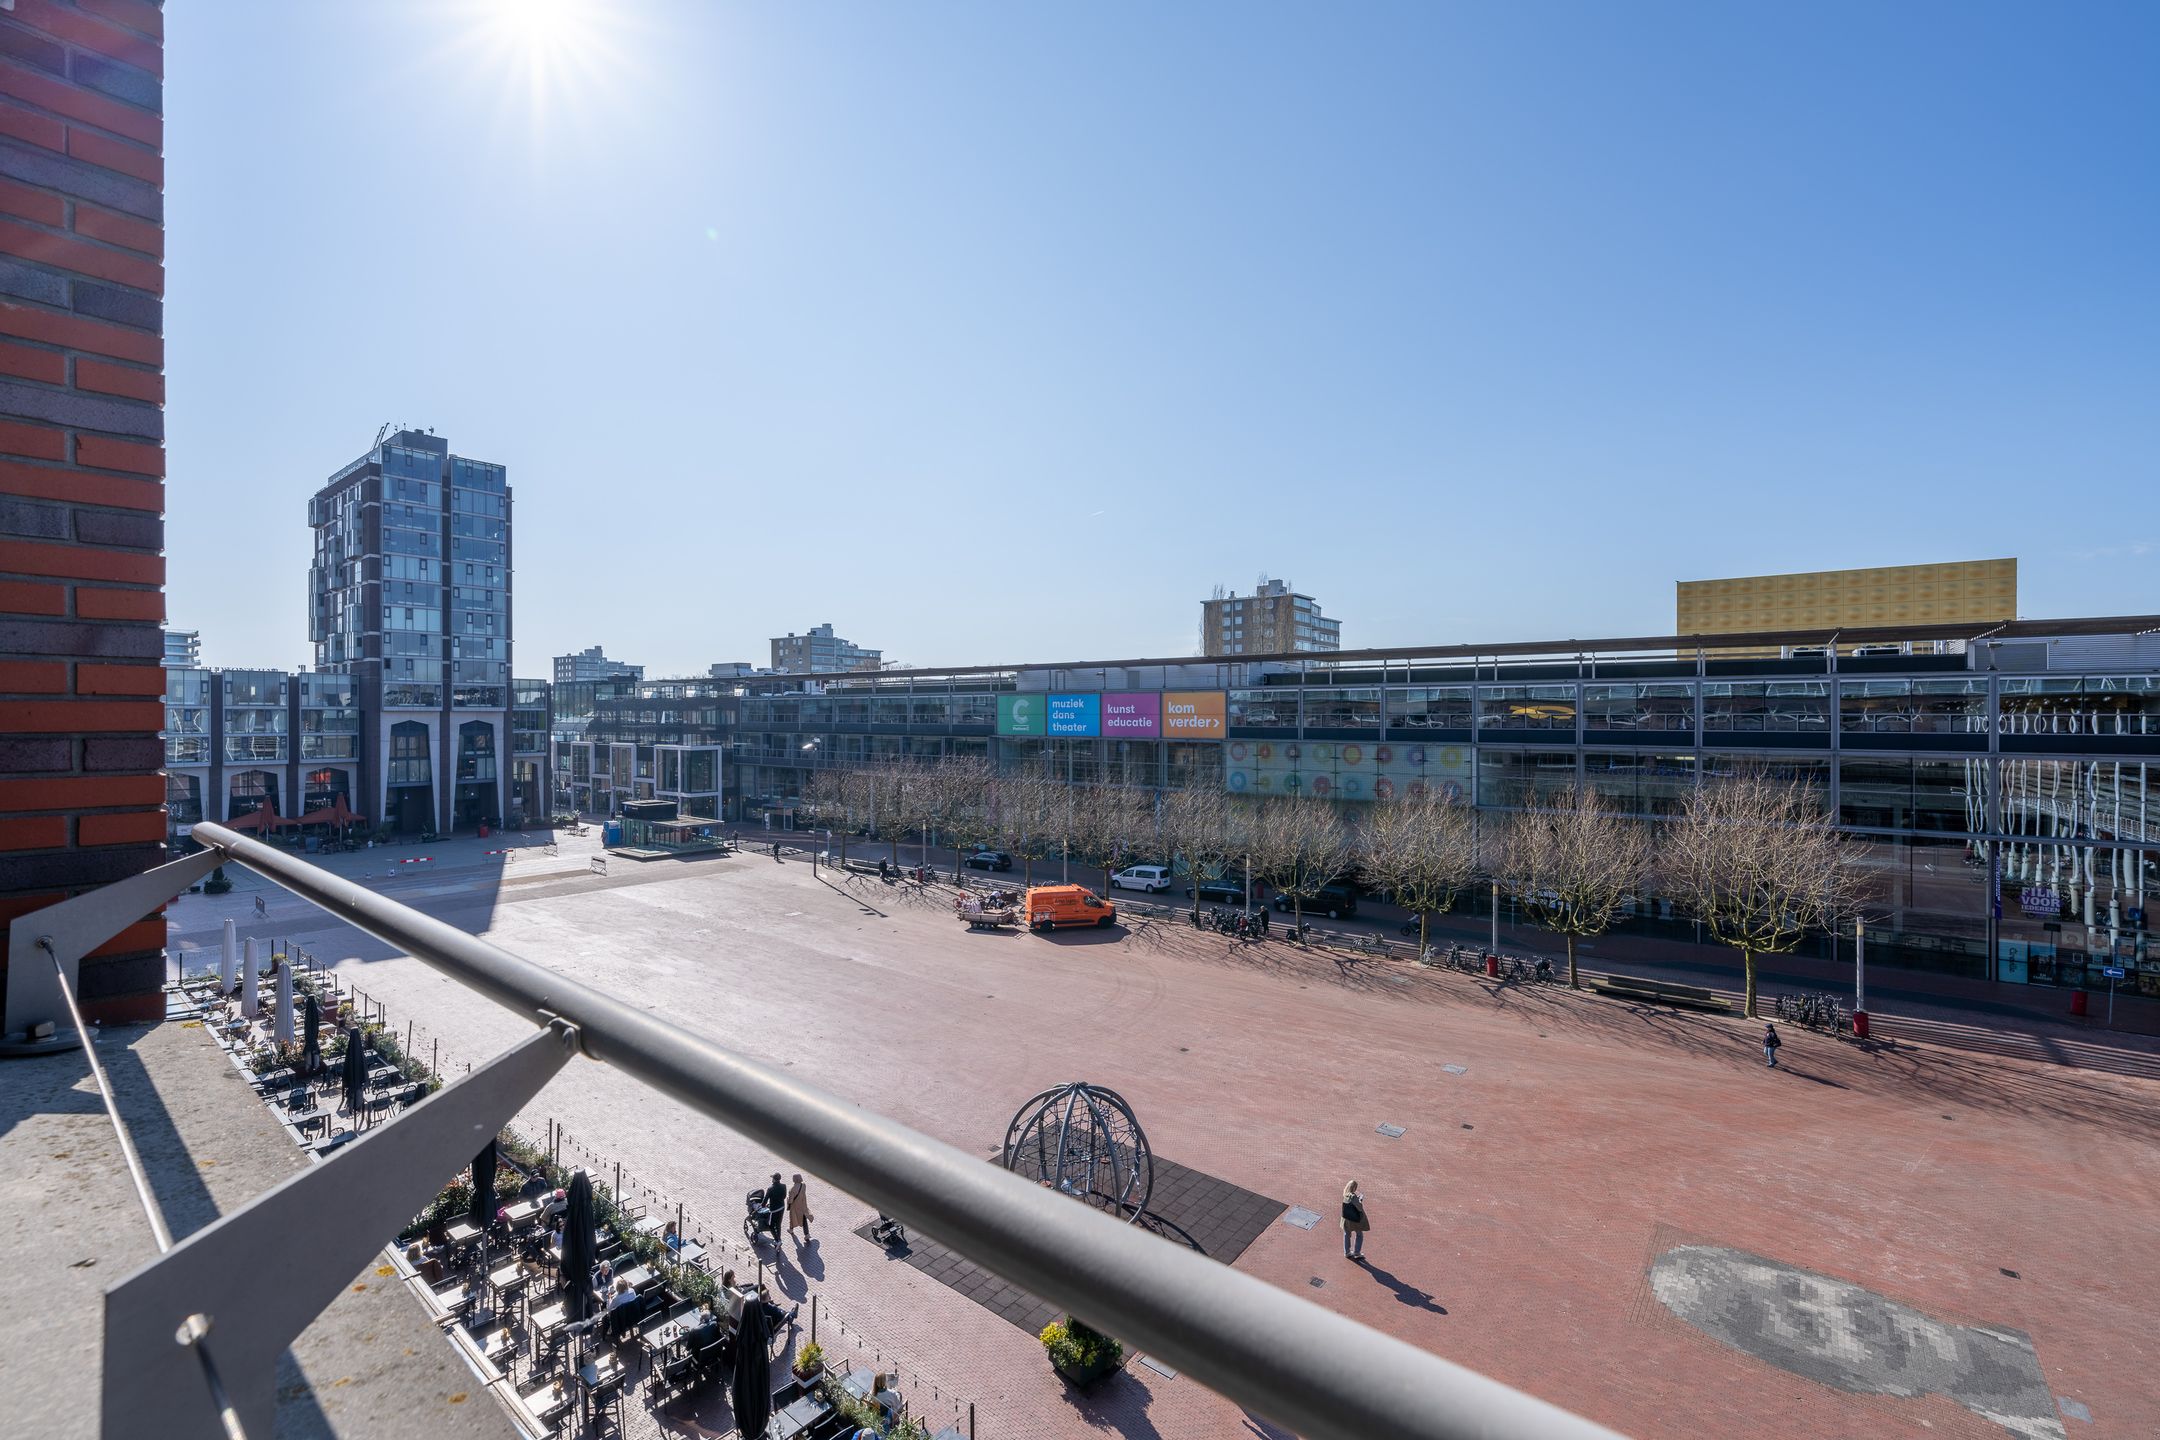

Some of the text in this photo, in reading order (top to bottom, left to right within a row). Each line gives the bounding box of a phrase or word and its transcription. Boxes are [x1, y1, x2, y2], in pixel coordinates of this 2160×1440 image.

[1052, 699, 1084, 708] muziek
[1168, 701, 1195, 714] kom
[1107, 704, 1135, 714] kunst
[1052, 710, 1075, 719] dans
[1107, 717, 1152, 727] educatie
[1168, 715, 1211, 728] verder
[1052, 722, 1087, 732] theater
[2021, 887, 2060, 898] FILM
[2021, 896, 2060, 907] VOOR
[2021, 904, 2060, 913] IEDEREEN
